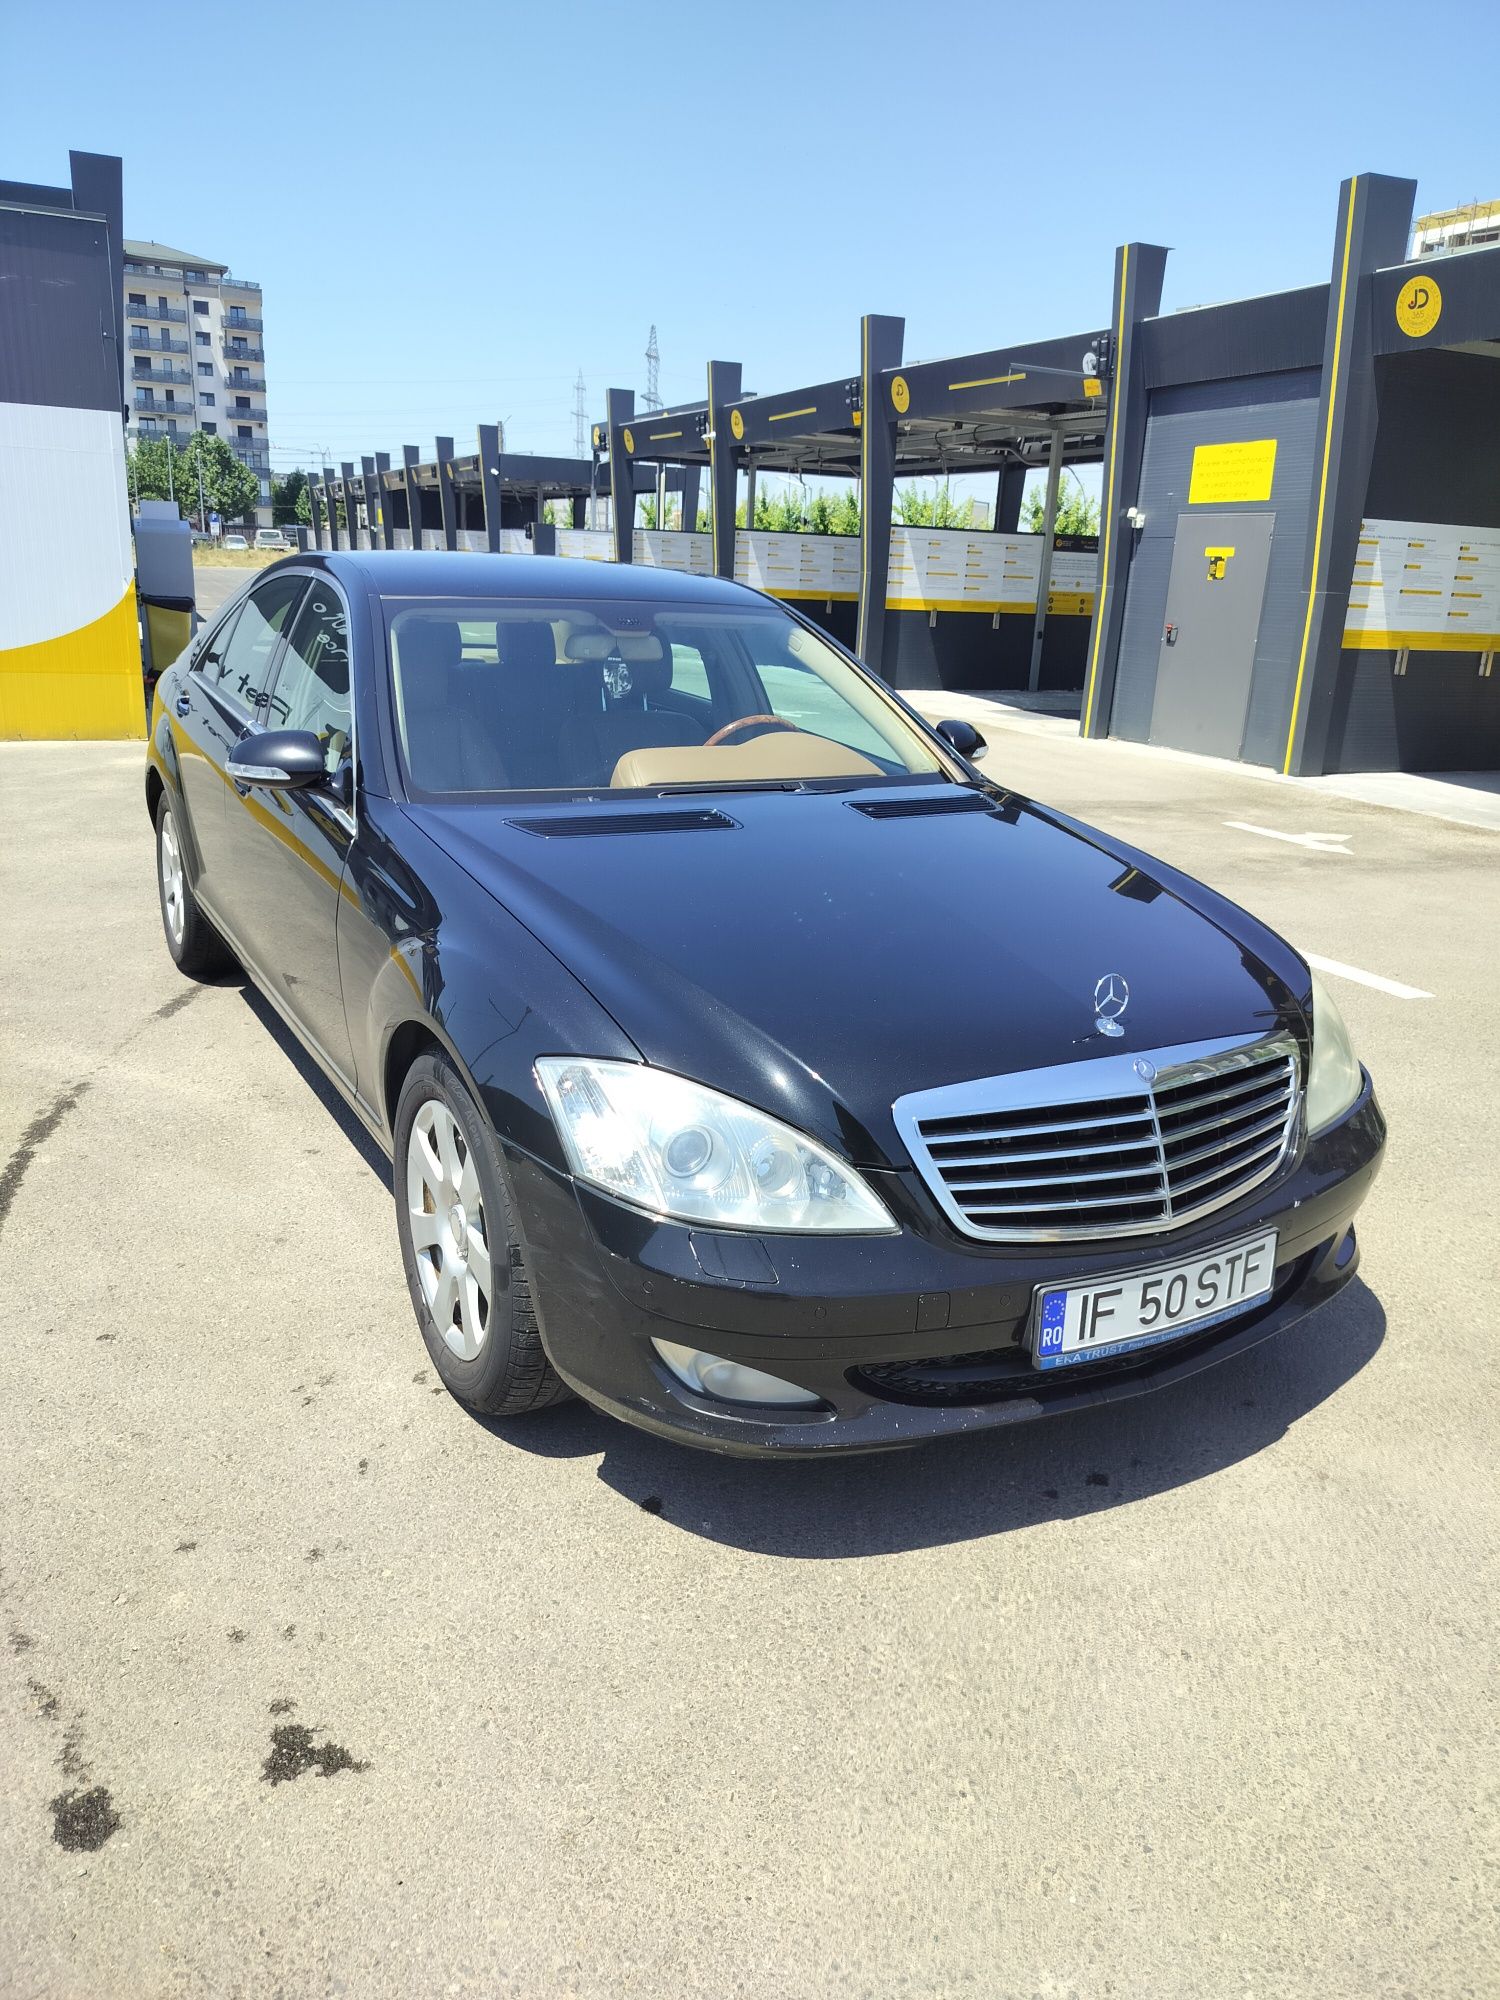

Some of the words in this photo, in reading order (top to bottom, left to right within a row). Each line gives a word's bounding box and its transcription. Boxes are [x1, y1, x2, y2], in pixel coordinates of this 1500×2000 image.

[1078, 1288, 1123, 1341] IF
[1138, 1274, 1188, 1326] 50
[1195, 1243, 1266, 1309] STF
[1042, 1326, 1063, 1348] RO
[1055, 1353, 1081, 1366] EKA
[1086, 1344, 1126, 1360] TRUST
